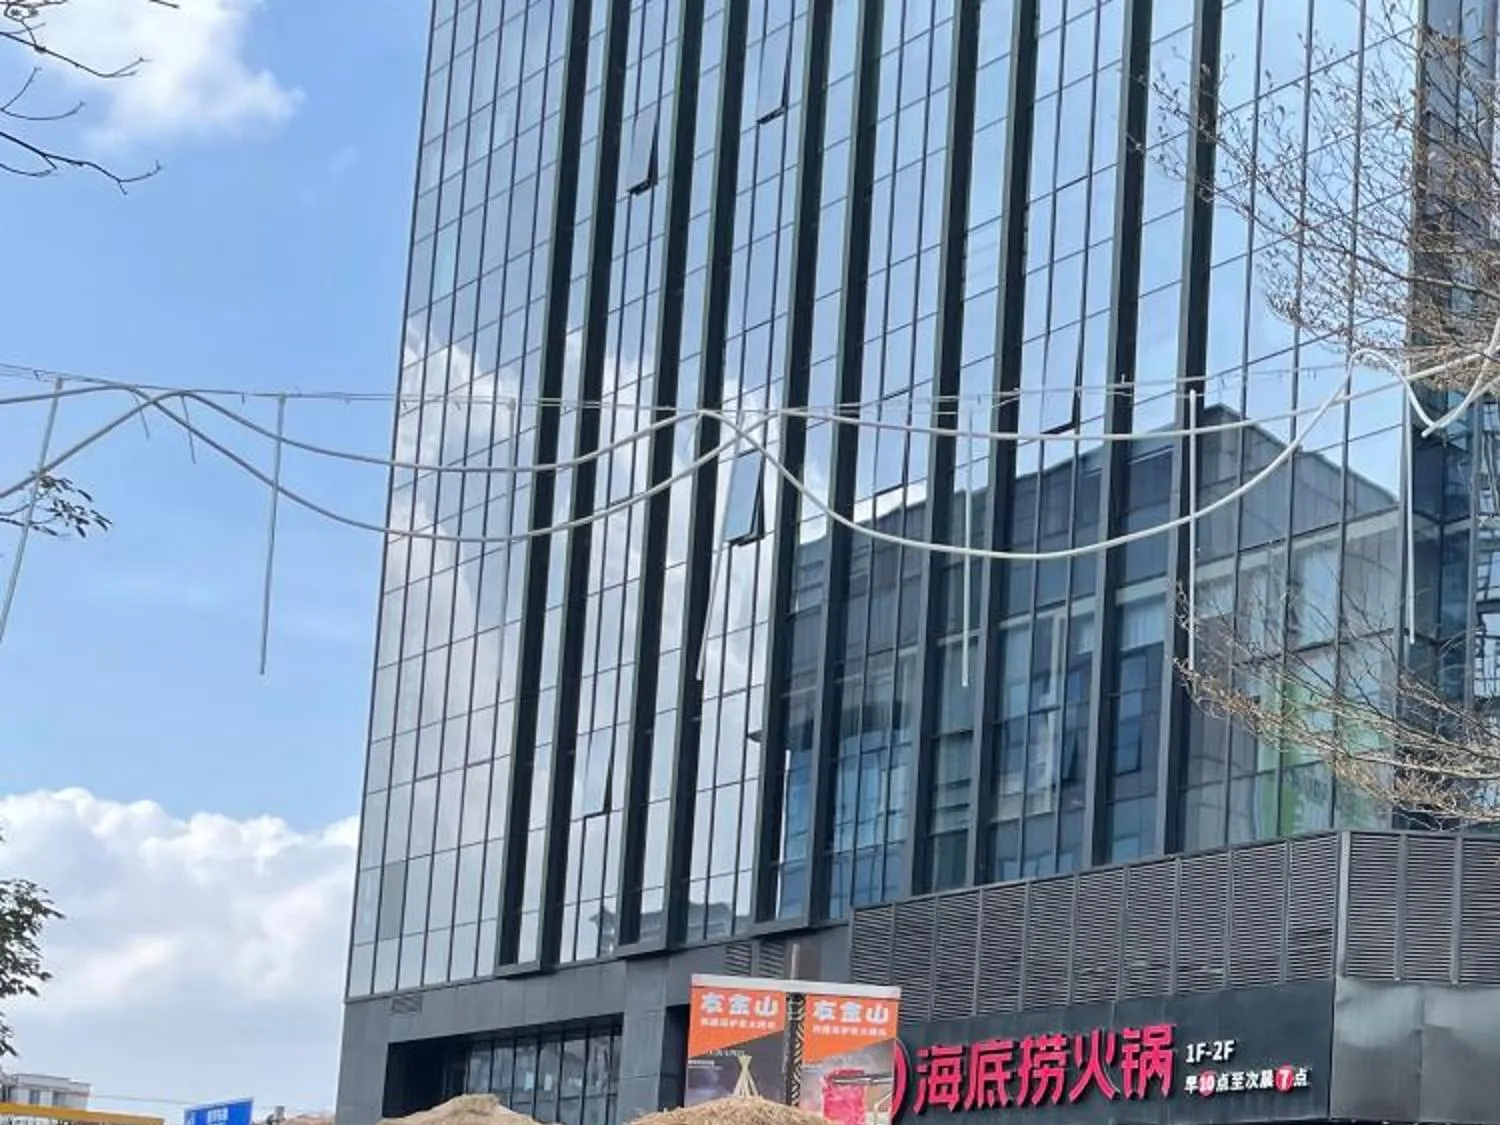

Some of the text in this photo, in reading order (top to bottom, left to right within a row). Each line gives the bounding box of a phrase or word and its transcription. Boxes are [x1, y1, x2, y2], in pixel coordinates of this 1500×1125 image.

[913, 1024, 1175, 1114] 海底捞火锅
[1185, 1039, 1236, 1063] 1F-2F
